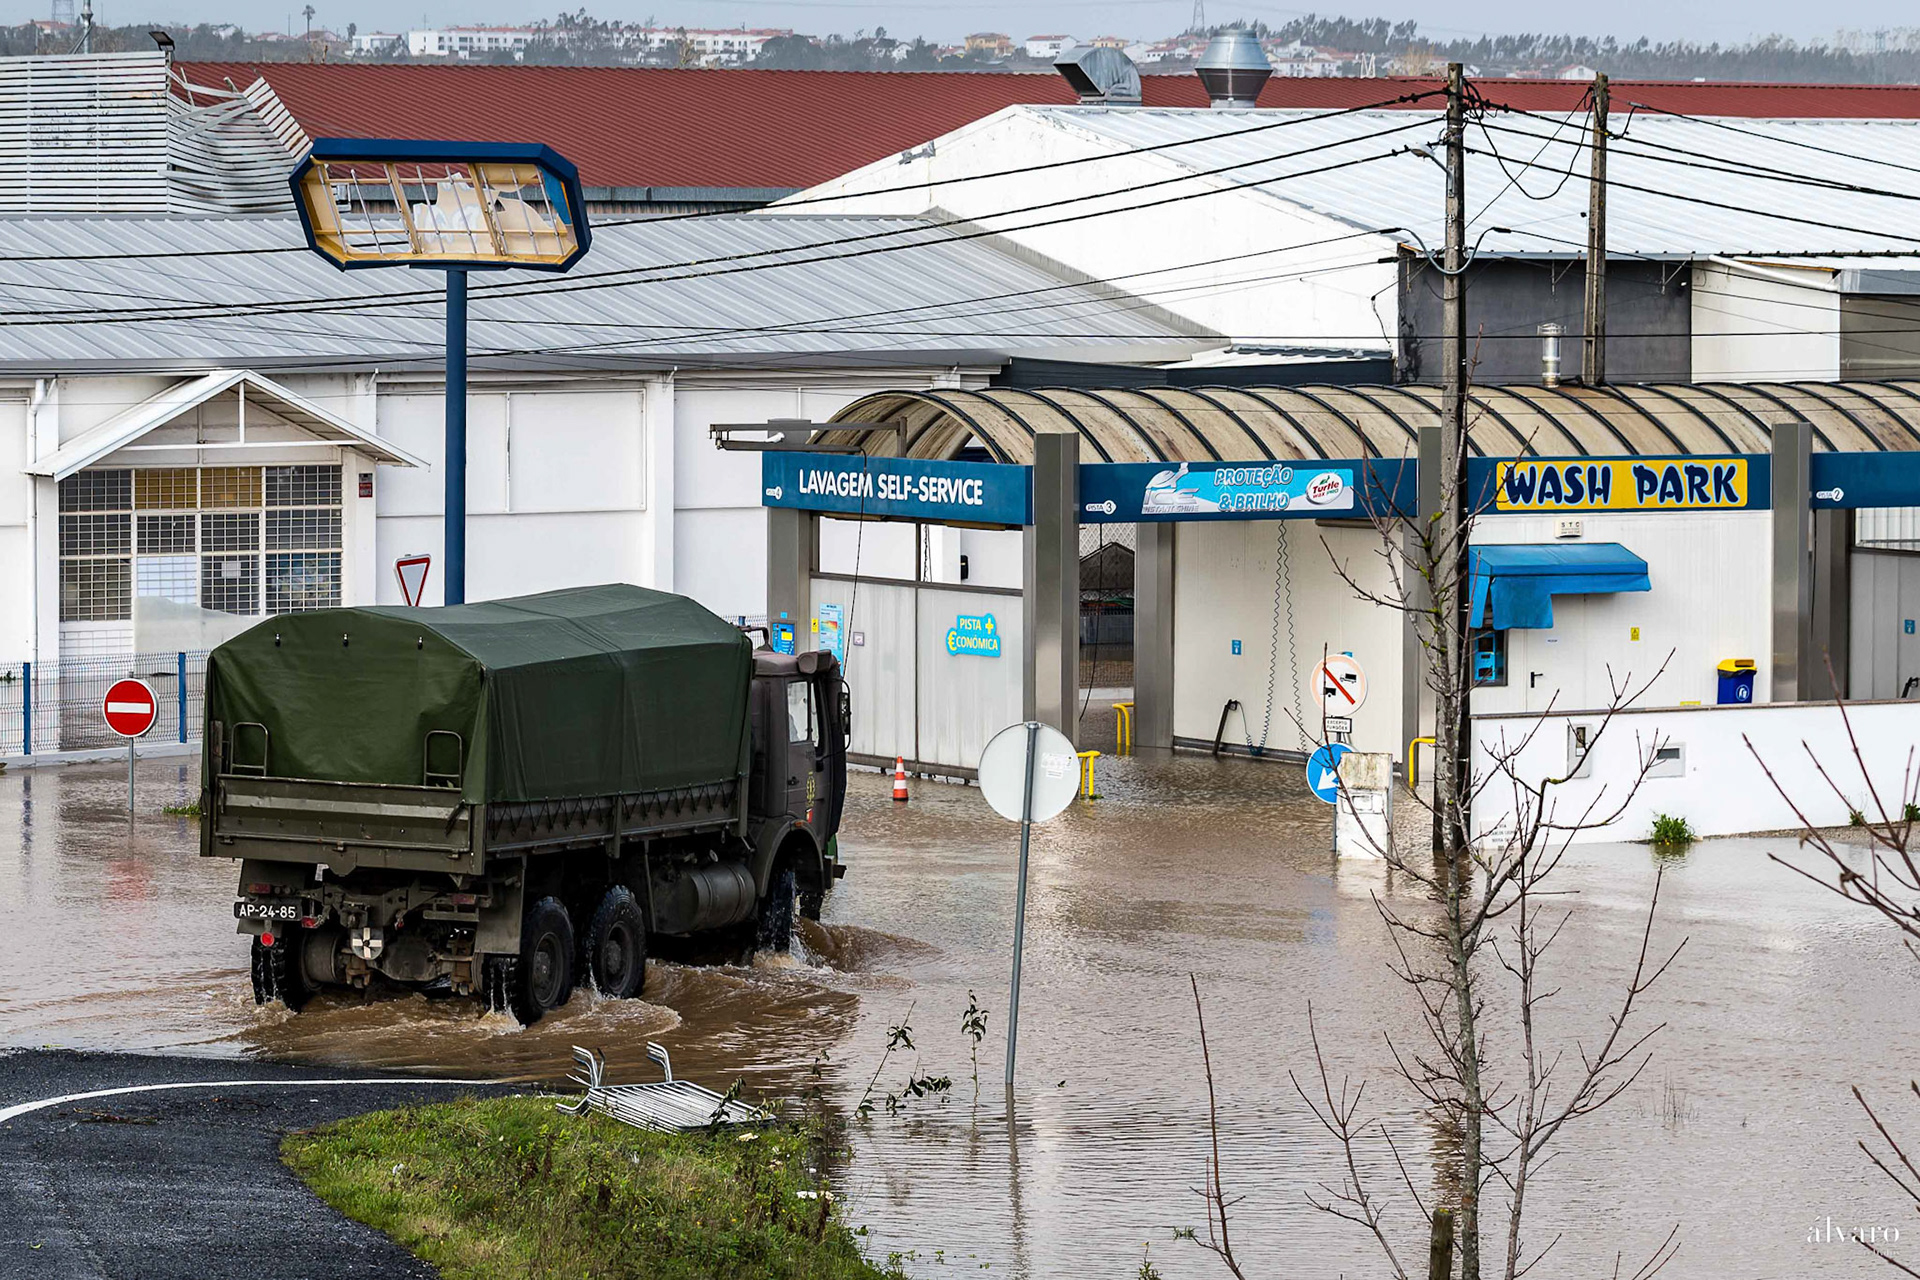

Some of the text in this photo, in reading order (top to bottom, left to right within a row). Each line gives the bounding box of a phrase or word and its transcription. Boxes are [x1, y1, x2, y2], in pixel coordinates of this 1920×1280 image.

[1214, 464, 1294, 489] PROTEÇÃO
[799, 468, 984, 506] LAVAGEM SELF-SERVICE
[1312, 481, 1340, 494] Turtle
[1506, 464, 1740, 505] WASH PARK
[1219, 493, 1290, 511] & BRILHO
[1833, 489, 1840, 500] 2
[1105, 502, 1112, 512] 3
[960, 618, 982, 630] PISTA
[239, 904, 296, 919] AP-24-85
